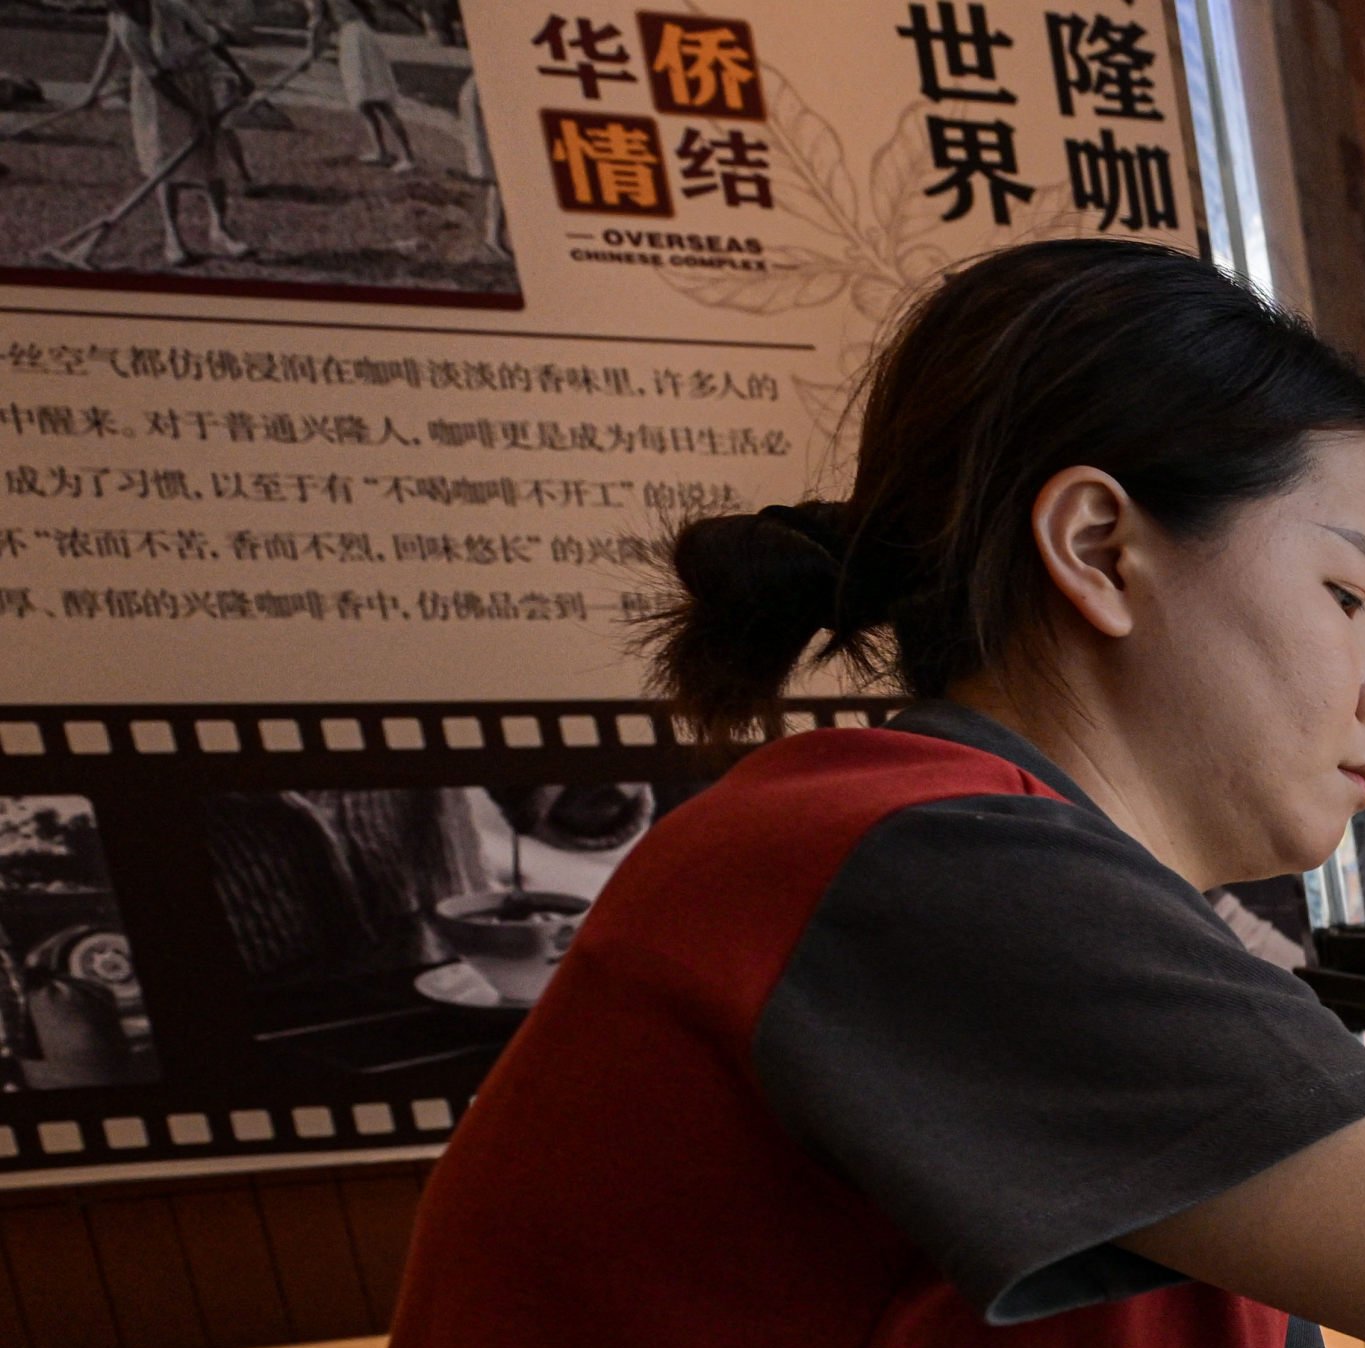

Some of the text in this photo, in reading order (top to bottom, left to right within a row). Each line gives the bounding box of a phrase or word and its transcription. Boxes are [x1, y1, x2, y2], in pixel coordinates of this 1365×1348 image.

[531, 14, 754, 110] 华侨
[896, 2, 1036, 226] 世界
[1045, 0, 1179, 231] 隆咖
[553, 119, 774, 209] 情结
[570, 248, 768, 273] CHINESE COMPLEX
[602, 229, 763, 255] OVERSEAS
